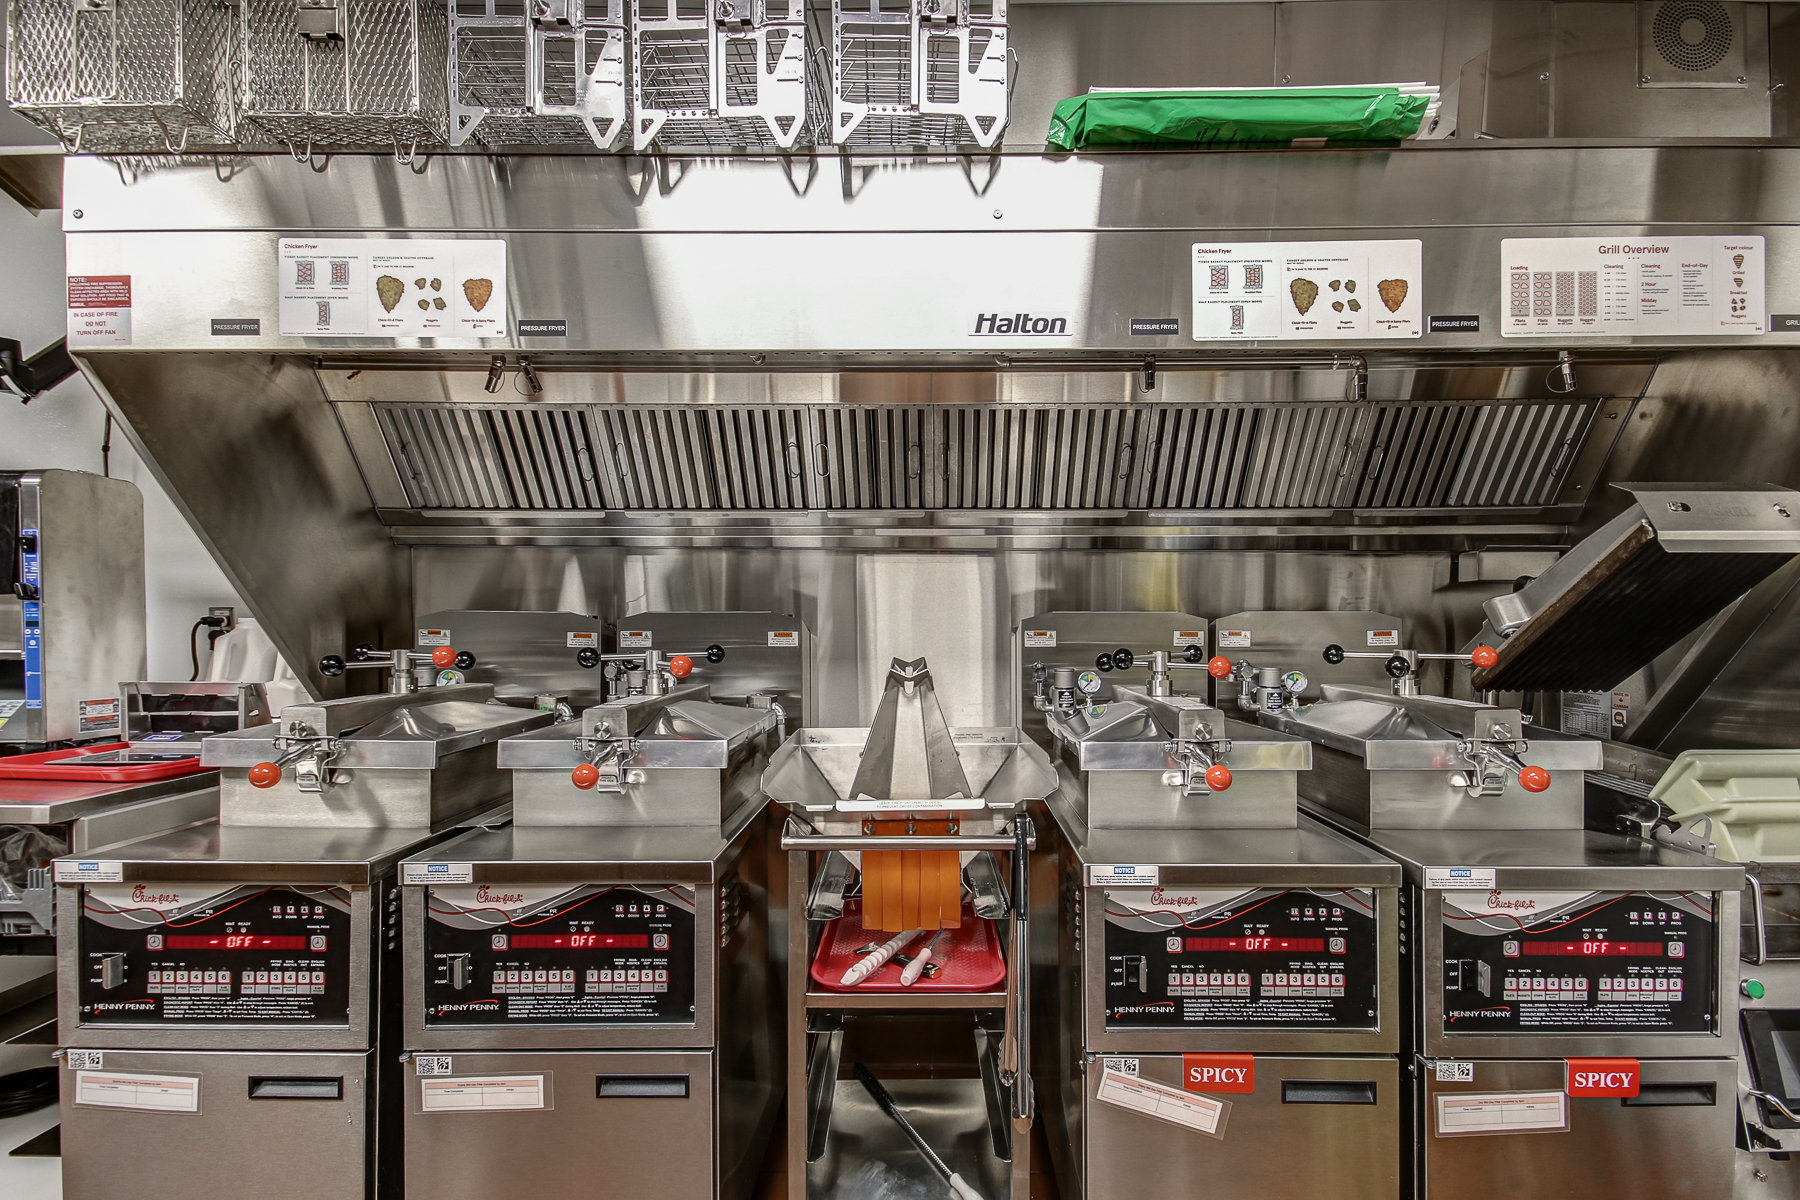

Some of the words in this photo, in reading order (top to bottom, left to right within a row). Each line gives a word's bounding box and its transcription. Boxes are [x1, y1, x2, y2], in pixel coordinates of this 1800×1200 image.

[1598, 245, 1619, 254] Grill
[1622, 244, 1669, 254] Overview
[975, 314, 1067, 334] Halton
[132, 885, 179, 904] Chick-fil-A
[476, 885, 523, 904] Chick-fil-A
[1151, 888, 1198, 907] Chick-fil-A
[1488, 891, 1535, 909] Chick-fil-A
[226, 936, 254, 948] OFF
[571, 935, 596, 947] OFF
[1246, 938, 1270, 950] OFF
[1584, 942, 1609, 953] OFF
[1190, 1067, 1247, 1083] SPICY
[1574, 1073, 1633, 1088] SPICY
